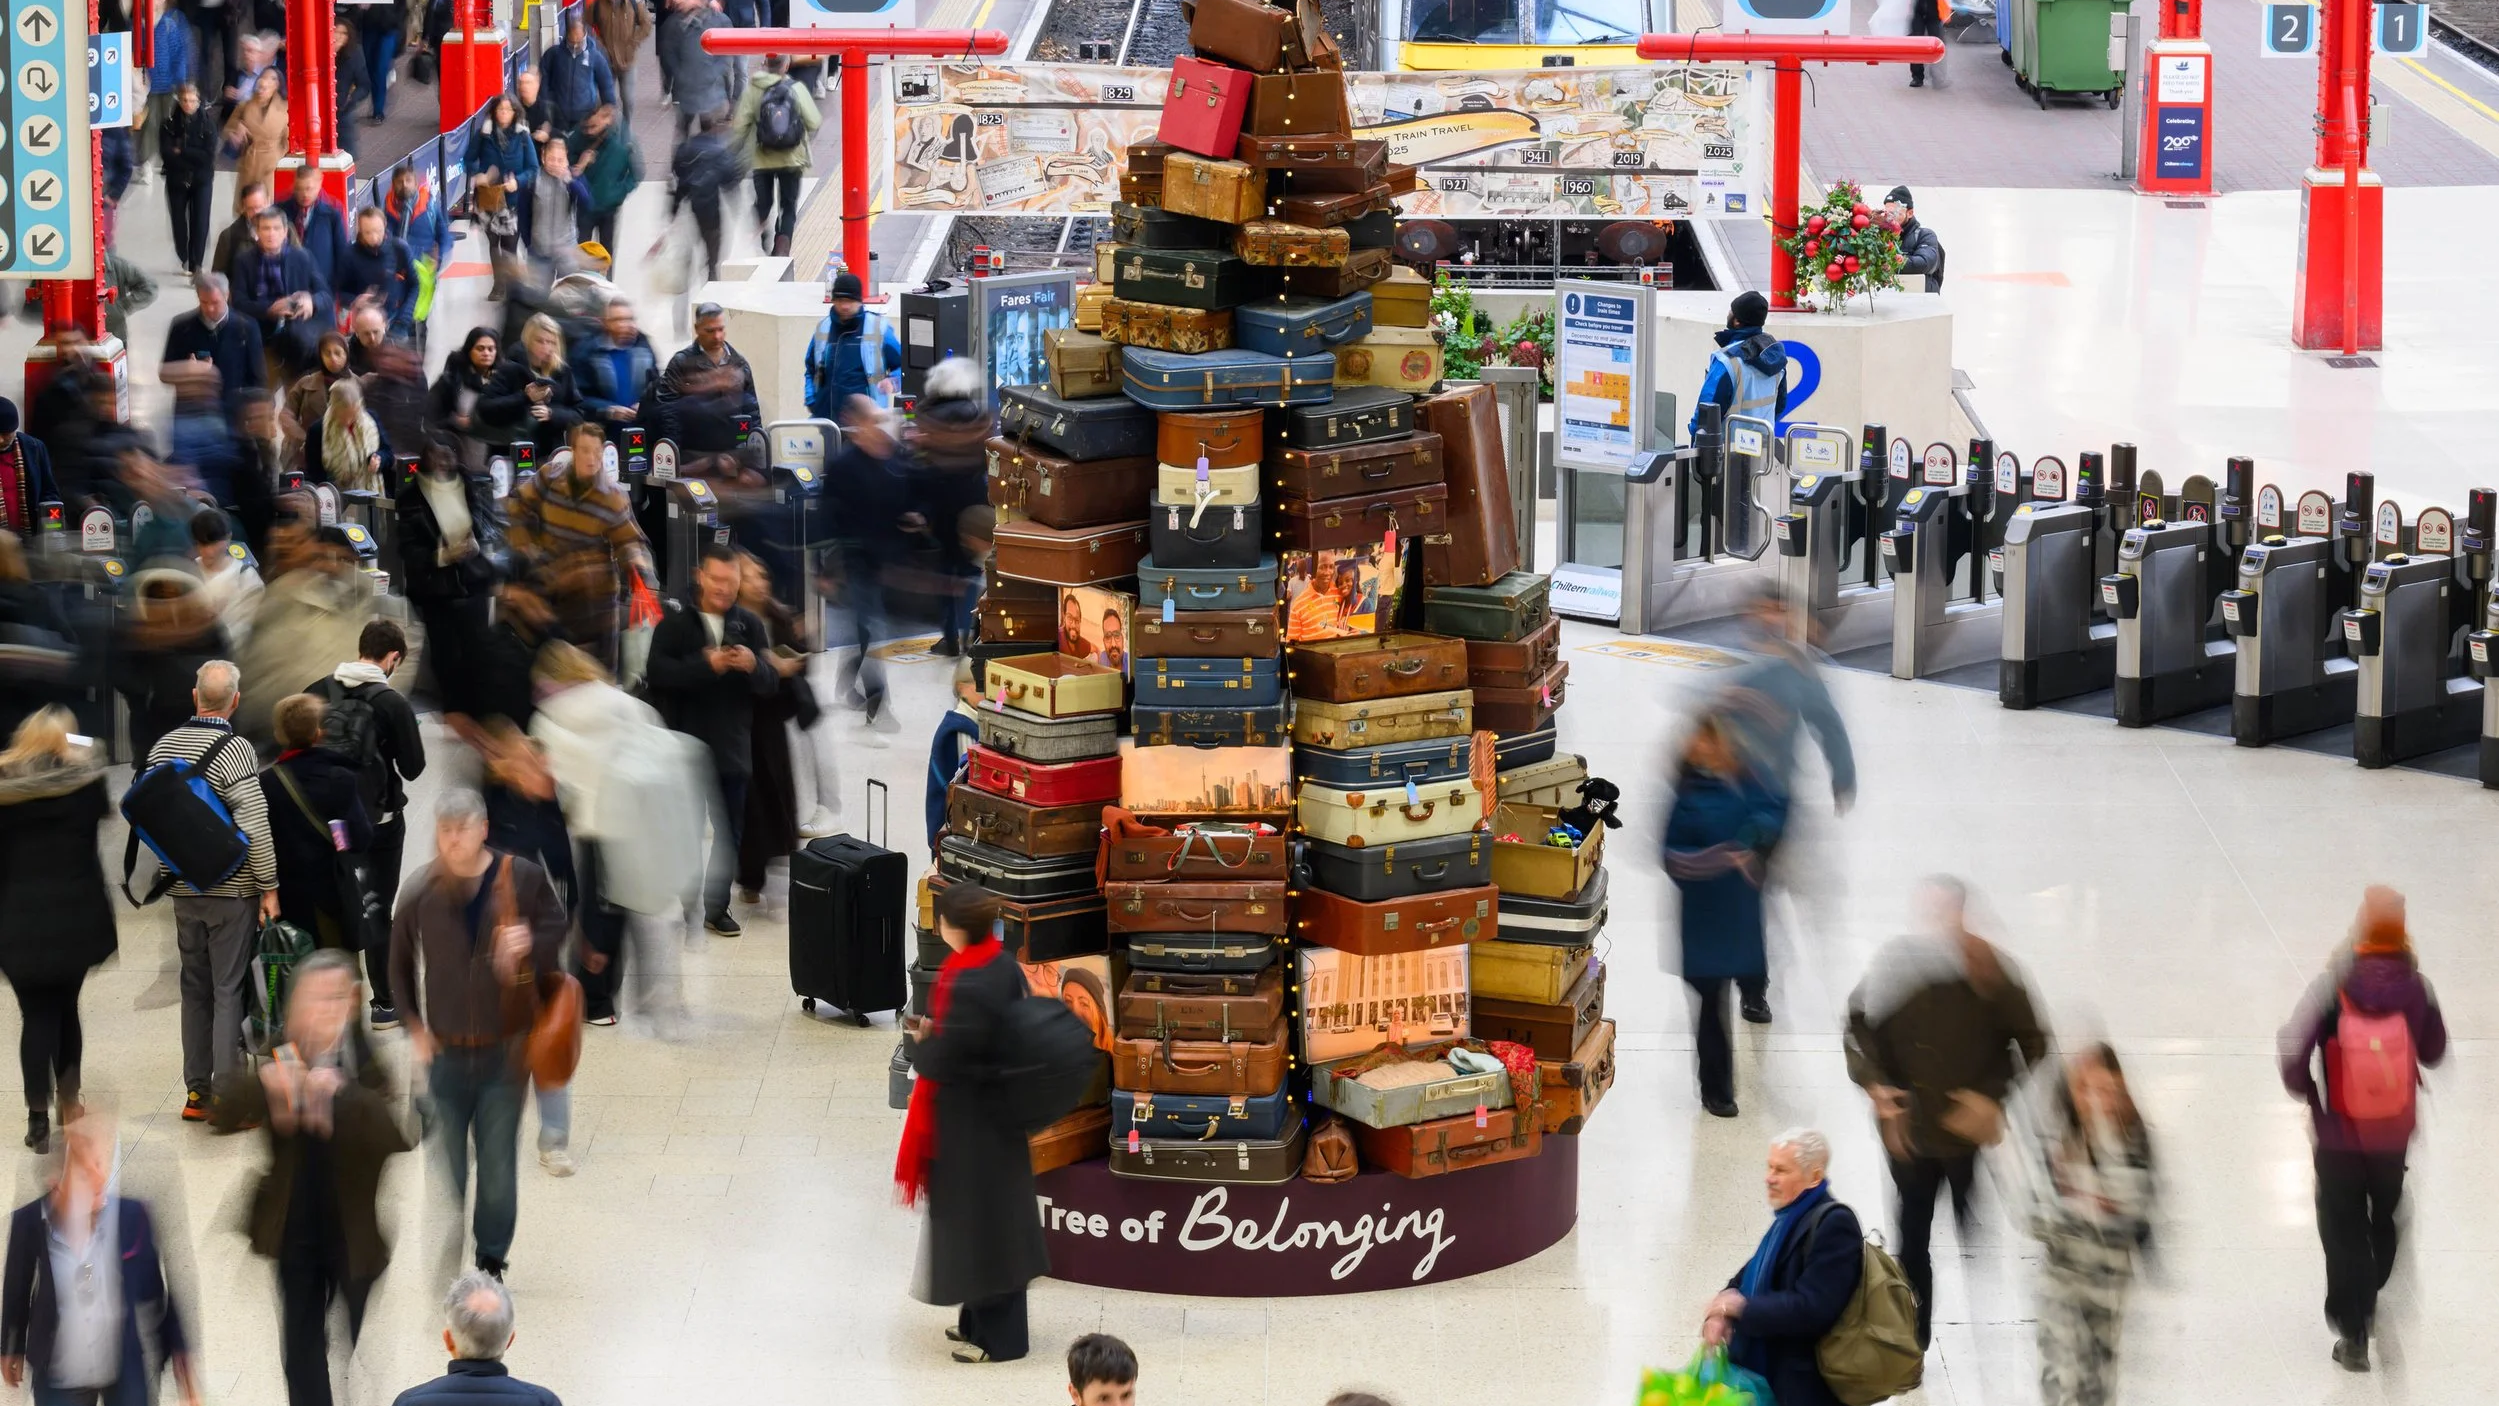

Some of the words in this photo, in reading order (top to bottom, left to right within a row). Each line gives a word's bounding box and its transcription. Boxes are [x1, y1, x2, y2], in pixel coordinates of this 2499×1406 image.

[2280, 14, 2300, 42] 2
[2393, 14, 2405, 42] 1
[1105, 87, 1132, 99] 1829
[979, 113, 1002, 125] 1825
[2163, 135, 2192, 151] 200
[1523, 151, 1546, 161] 1941
[1706, 146, 1733, 157] 2025
[1616, 153, 1641, 164] 2019
[1442, 179, 1467, 190] 1927
[1565, 181, 1592, 194] 1960
[1001, 294, 1031, 307] Fares
[1034, 290, 1056, 303] Fair
[1597, 301, 1616, 309] Changes
[1571, 332, 1593, 340] December
[1610, 337, 1627, 345] January
[1774, 340, 1821, 439] 2
[1551, 580, 1620, 599] Chilternrailway
[1037, 1195, 1109, 1238] Tree
[1120, 1210, 1167, 1244] of
[1178, 1186, 1456, 1281] Belonging
